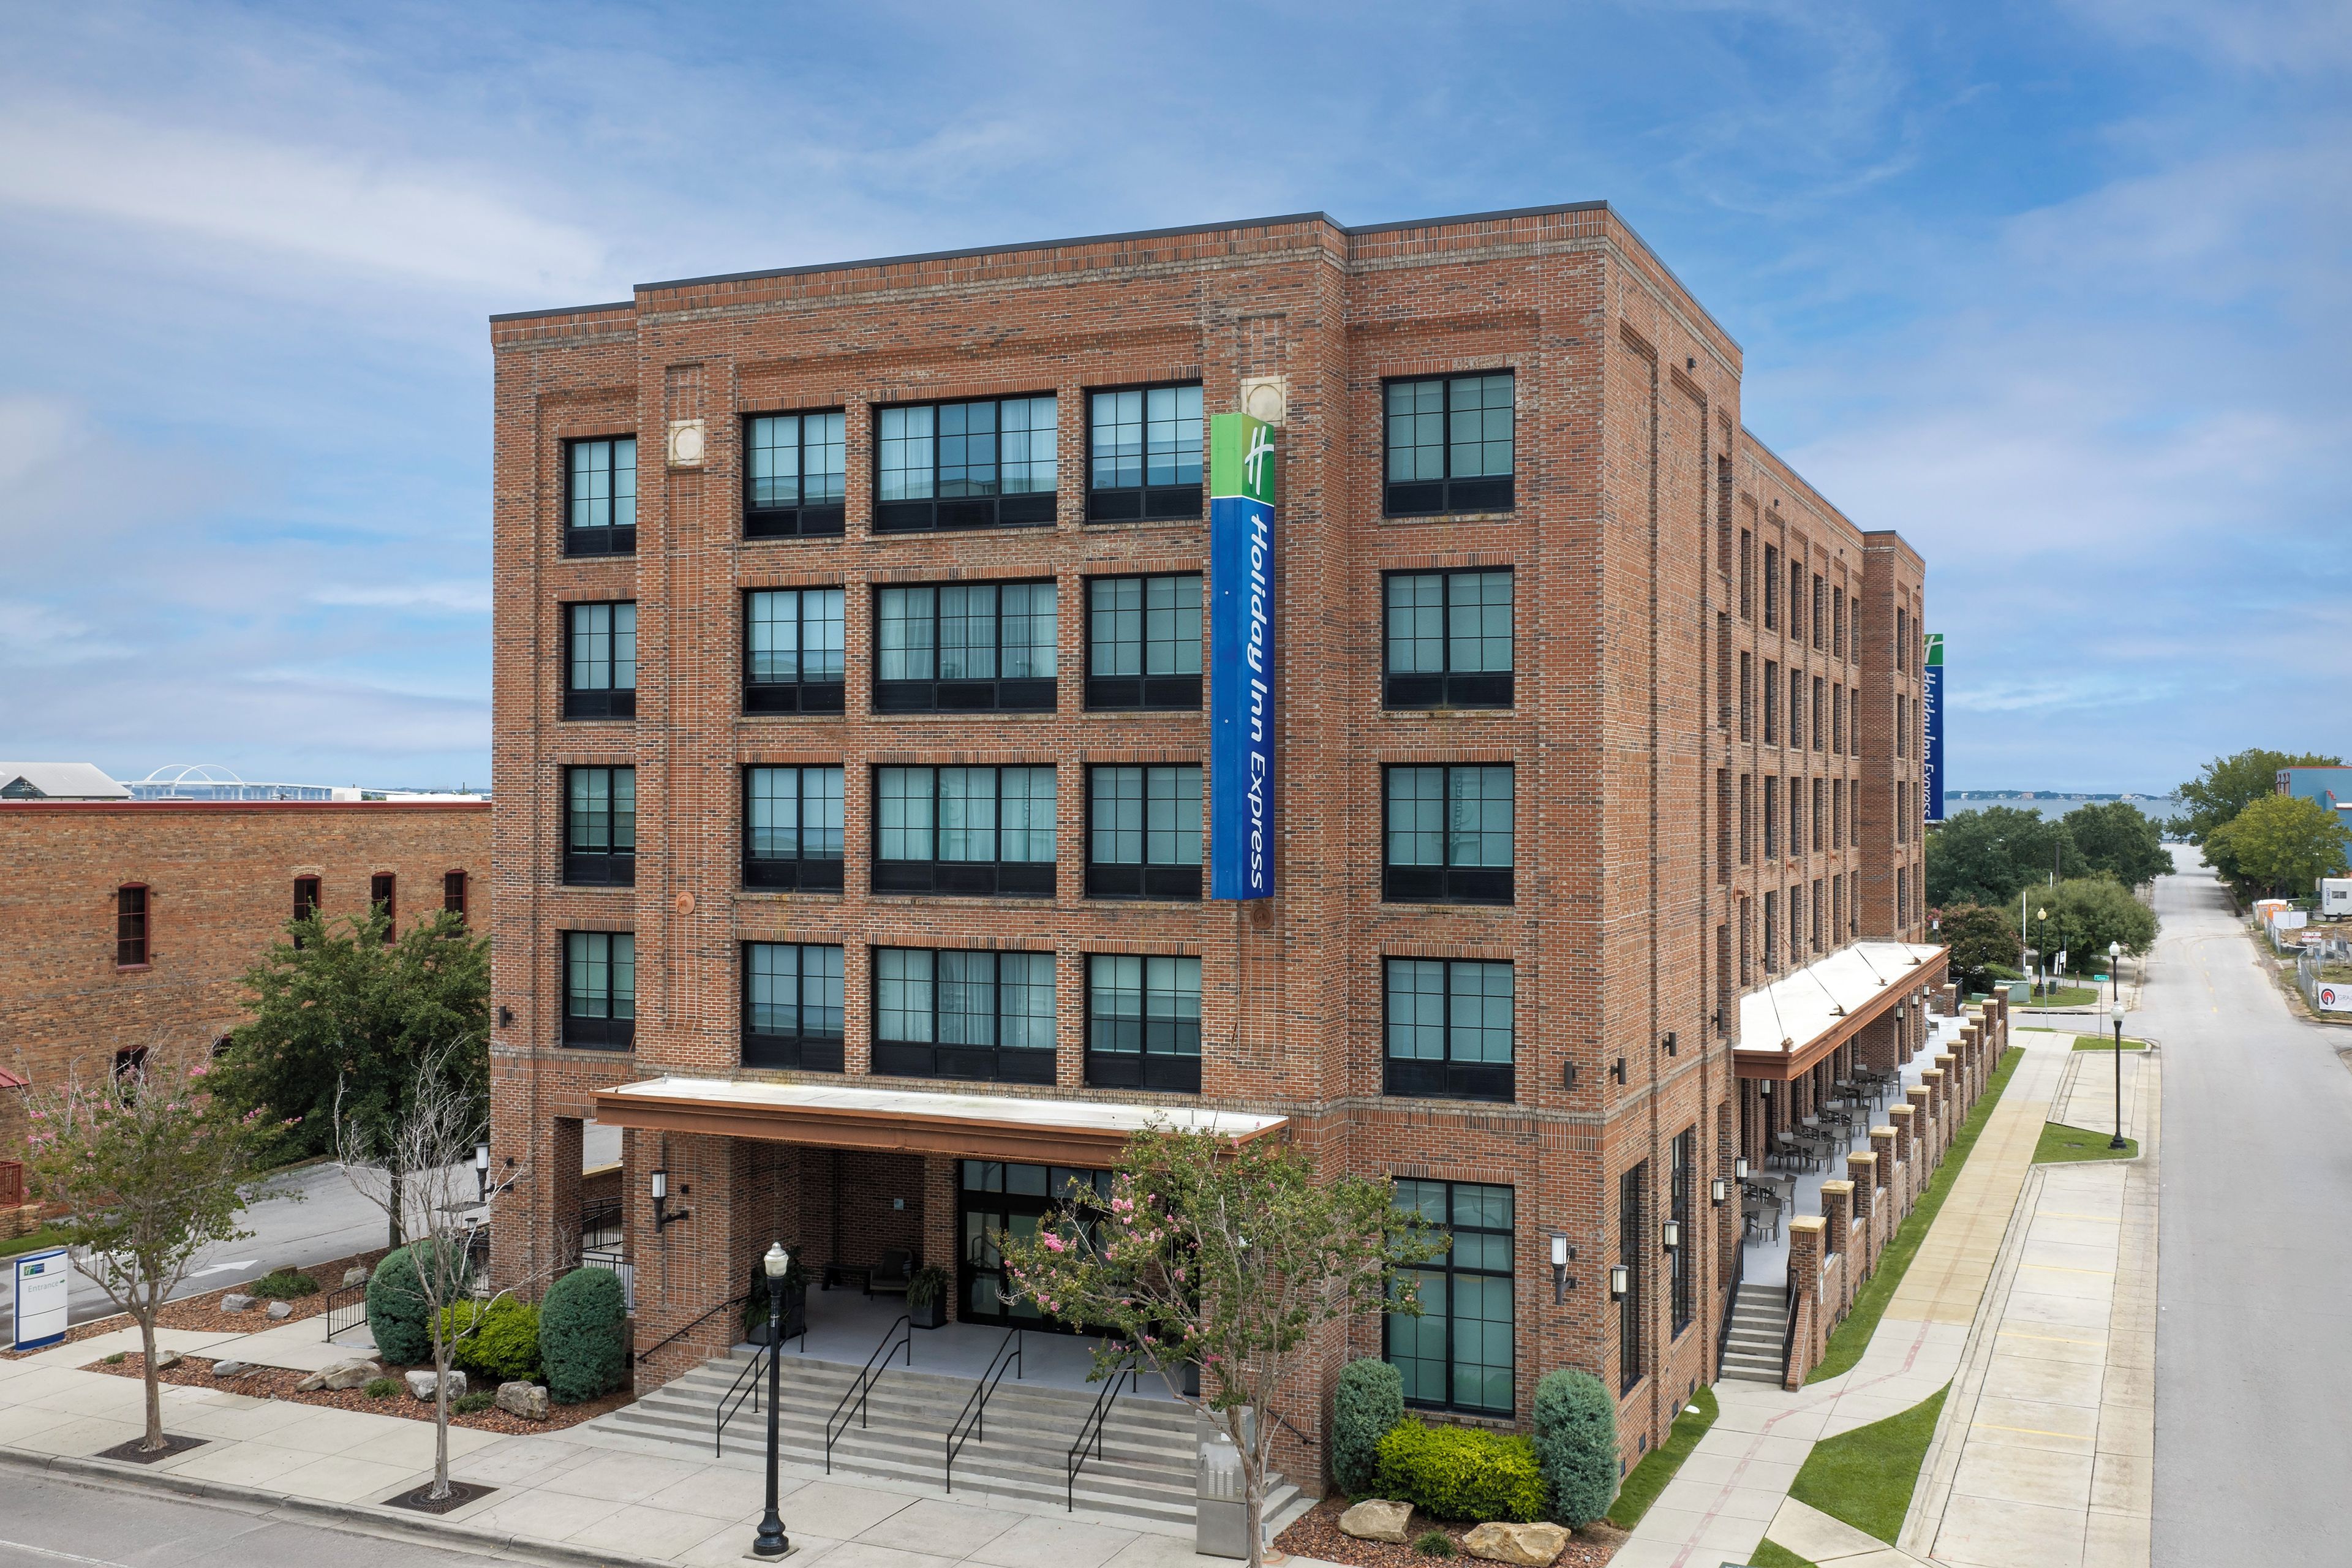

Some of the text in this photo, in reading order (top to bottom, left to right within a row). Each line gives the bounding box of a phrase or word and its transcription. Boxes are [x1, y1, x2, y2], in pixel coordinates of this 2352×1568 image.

[1247, 514, 1267, 889] Holiday Inn Express
[28, 1281, 59, 1292] Entrance
